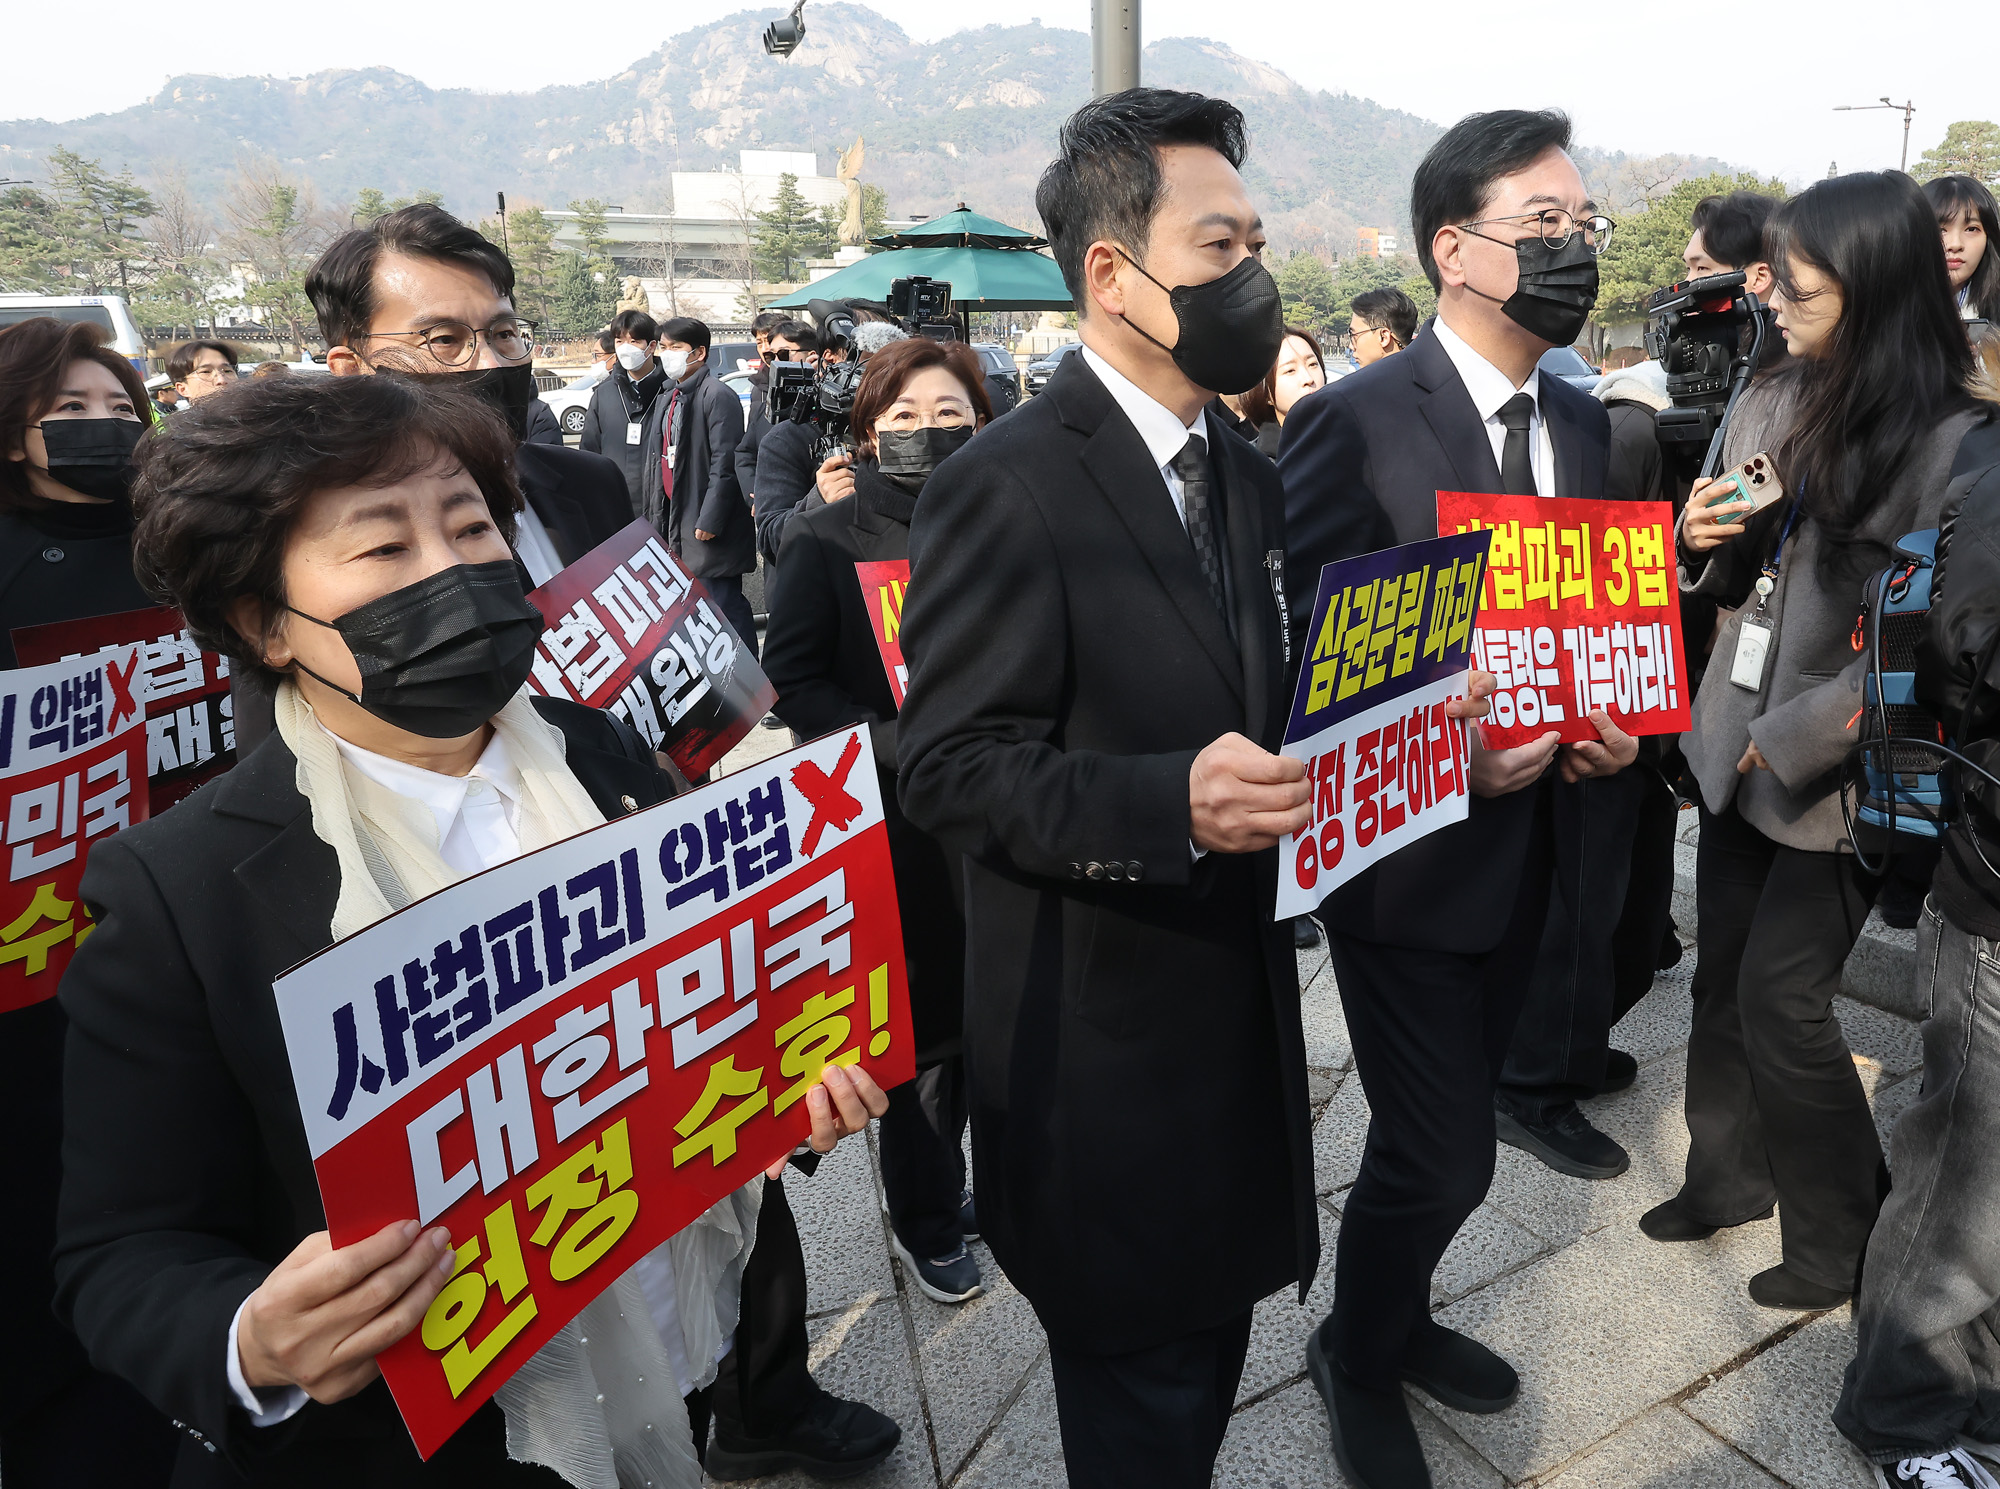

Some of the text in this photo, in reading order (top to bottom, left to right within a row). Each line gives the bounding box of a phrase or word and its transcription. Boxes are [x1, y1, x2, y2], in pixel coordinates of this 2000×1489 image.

[591, 536, 694, 649] 파괴
[1456, 518, 1669, 610] 법파괴 3법
[650, 596, 734, 727] 완성
[1305, 552, 1483, 716] 삼권분립 파괴
[1562, 621, 1678, 718] 거부하라!
[29, 667, 104, 753] 악법
[1353, 695, 1470, 848] 중단하라!
[0, 749, 131, 882] 민국
[0, 882, 96, 976] 수
[327, 776, 793, 1121] 사법파괴 악법
[406, 866, 855, 1227] 대한민국
[421, 962, 892, 1400] 헌정 수호!
